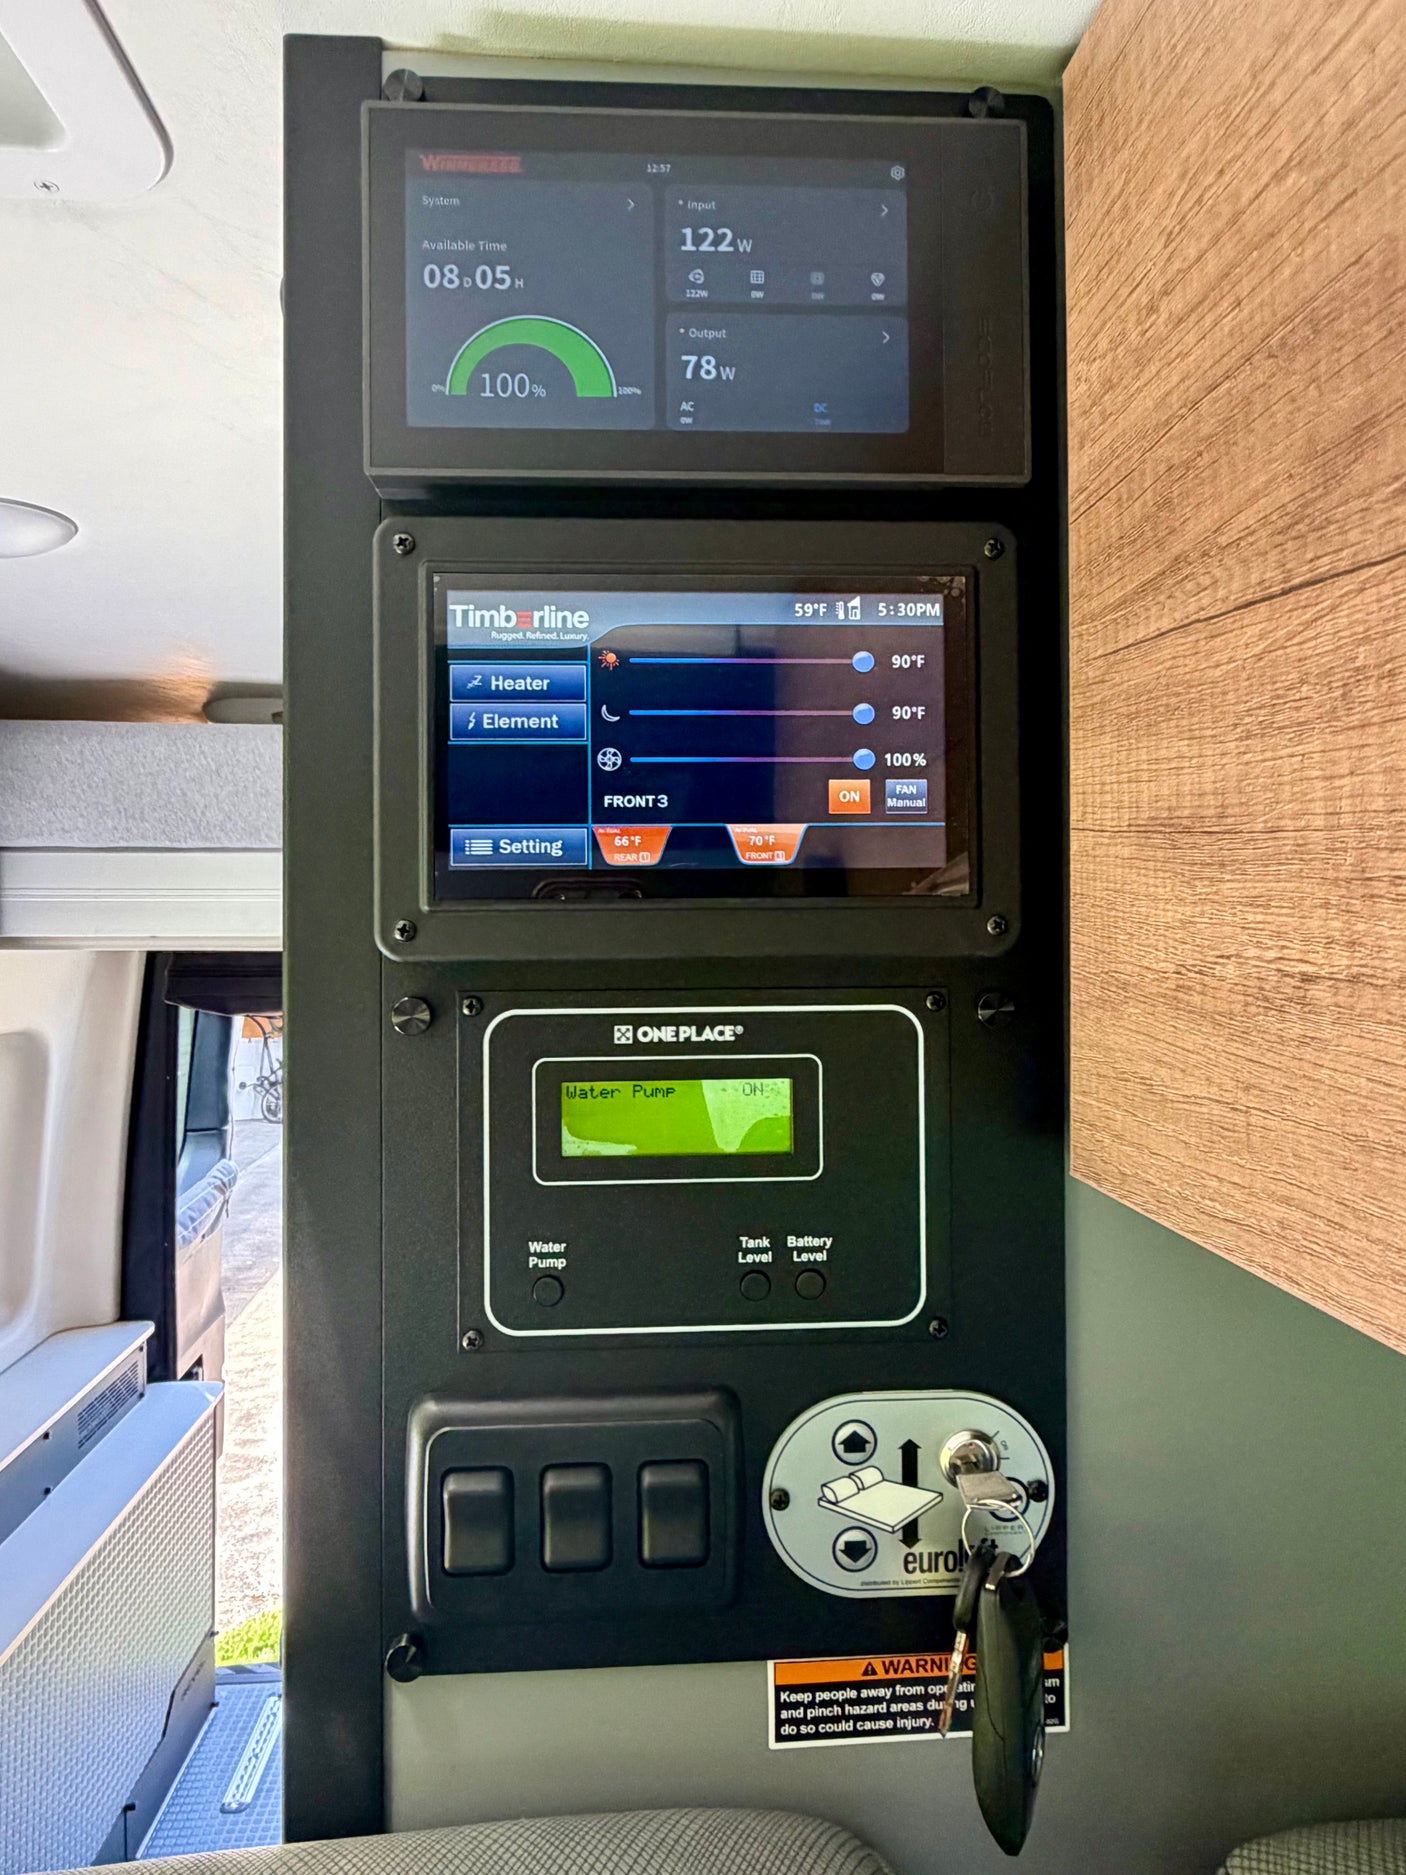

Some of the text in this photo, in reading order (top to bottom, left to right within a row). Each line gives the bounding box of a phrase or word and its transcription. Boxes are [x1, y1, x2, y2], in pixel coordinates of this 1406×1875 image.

[421, 195, 460, 208] System
[687, 200, 716, 211] Input
[421, 239, 507, 252] Available Time
[688, 327, 727, 340] Output
[680, 401, 695, 412] AC
[449, 604, 590, 629] Timberline
[794, 603, 828, 617] 59°F
[491, 631, 590, 642] Rugged. Refined. Luxury.
[892, 654, 925, 669] 90°F
[490, 675, 550, 691] Heater
[892, 706, 926, 720] 90°F
[483, 713, 559, 729] Element
[885, 752, 927, 767] 100%
[896, 784, 917, 795] FAN
[604, 795, 668, 808] FRONT 3
[839, 790, 860, 803] ON
[887, 798, 926, 809] Manual
[500, 839, 563, 857] Setting
[614, 853, 638, 862] REAR
[745, 852, 773, 860] FRONT
[566, 1082, 764, 1099] Water Pump ON
[529, 1241, 566, 1254] Water
[739, 1236, 770, 1248] Tank
[787, 1235, 833, 1249] Battery
[738, 1251, 772, 1263] Level
[793, 1250, 827, 1262] Level
[528, 1257, 567, 1269] Pump
[882, 1655, 977, 1675] WARNIG
[780, 1691, 812, 1704] Keep
[815, 1688, 857, 1702] people
[860, 1686, 892, 1699] away
[895, 1684, 925, 1696] from
[780, 1707, 804, 1719] and
[807, 1705, 841, 1719] pinch
[845, 1702, 887, 1715] hazard
[889, 1701, 924, 1713] areas
[780, 1716, 935, 1735] do so could cause injury.
